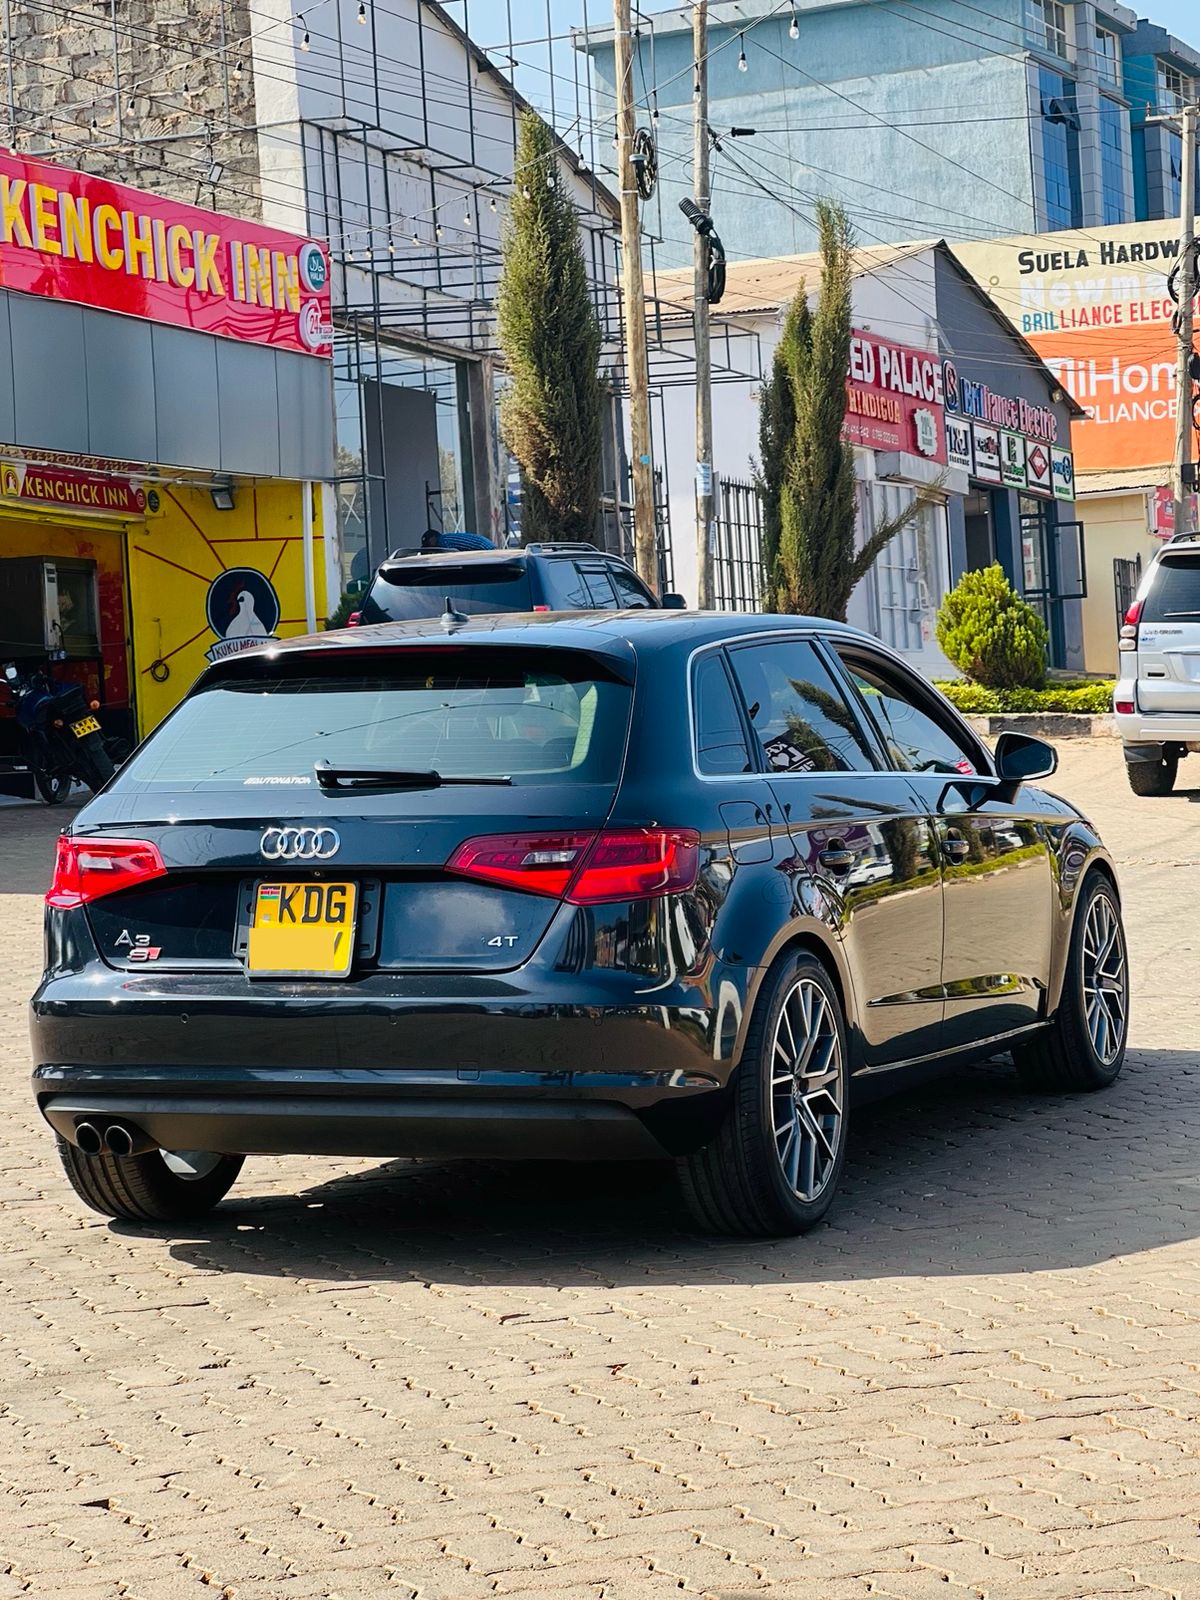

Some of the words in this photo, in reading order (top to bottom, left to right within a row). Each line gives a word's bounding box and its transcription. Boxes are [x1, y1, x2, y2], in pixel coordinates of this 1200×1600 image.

[0, 174, 226, 297] KENCHICK
[230, 240, 300, 313] INN
[1018, 250, 1089, 275] SUELA
[1022, 304, 1122, 333] BRILLIANCE
[846, 338, 876, 384] ED
[879, 345, 944, 405] PALACE
[847, 388, 901, 424] HINDIGUA
[960, 377, 1019, 430] Brilliance
[1015, 396, 1058, 443] Electric
[25, 475, 100, 505] KENCHICK
[102, 486, 129, 507] INN
[215, 641, 239, 658] KUKU
[279, 885, 347, 923] KDG
[114, 929, 151, 947] A3
[487, 936, 519, 947] 4T
